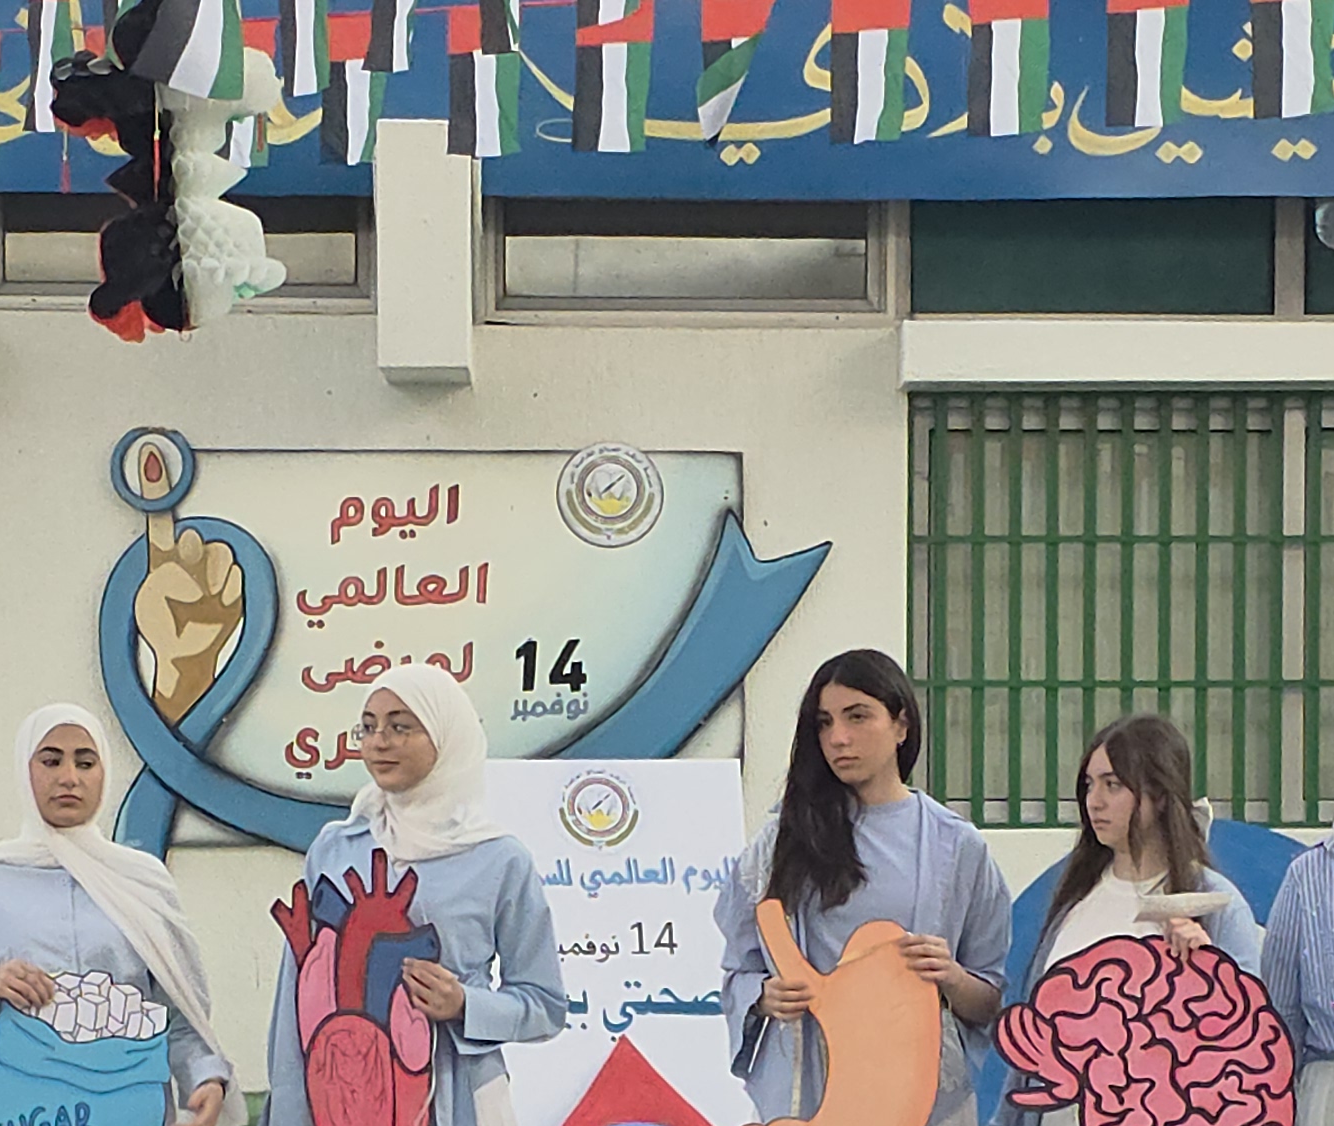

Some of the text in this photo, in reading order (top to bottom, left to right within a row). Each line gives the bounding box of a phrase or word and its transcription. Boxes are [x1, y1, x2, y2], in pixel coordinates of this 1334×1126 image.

[331, 483, 460, 545] اليوم
[296, 562, 489, 629] العالمي
[301, 640, 474, 693] لمضى
[515, 638, 587, 692] 14
[510, 691, 589, 721] نوفمبر
[580, 856, 675, 899] العالمي
[557, 921, 678, 963] 14 نوفمب
[602, 980, 725, 1043] صحتي
